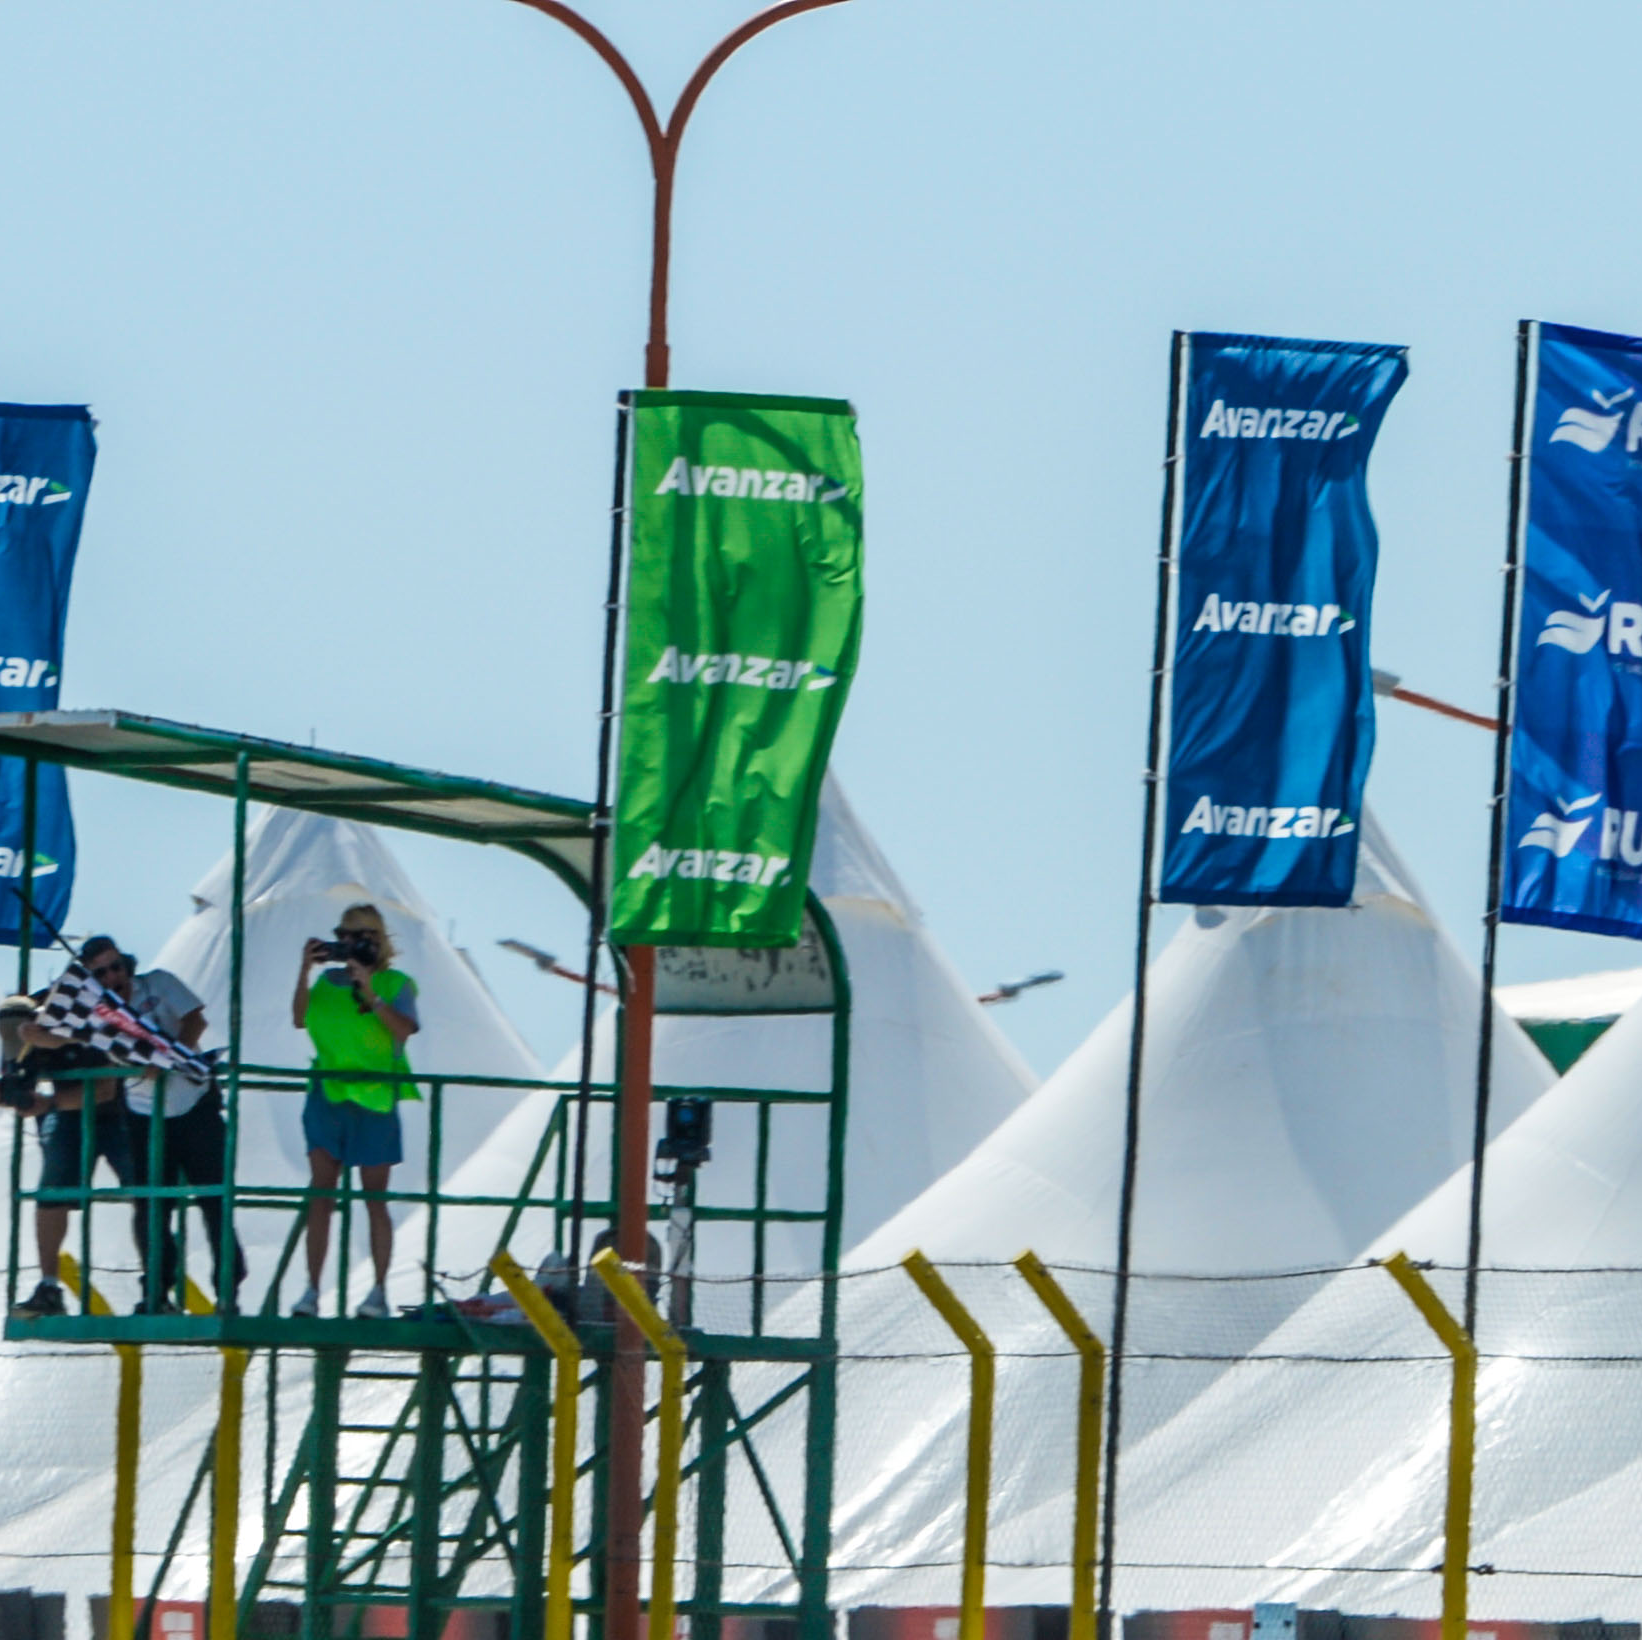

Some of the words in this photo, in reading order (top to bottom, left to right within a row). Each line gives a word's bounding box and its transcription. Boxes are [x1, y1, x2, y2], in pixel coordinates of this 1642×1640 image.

[1200, 399, 1346, 440] Avanzar
[655, 458, 824, 501] Avanzar
[1193, 593, 1341, 637] Avanzar
[647, 645, 815, 690] Avanzar
[1181, 795, 1340, 838] Avanzar
